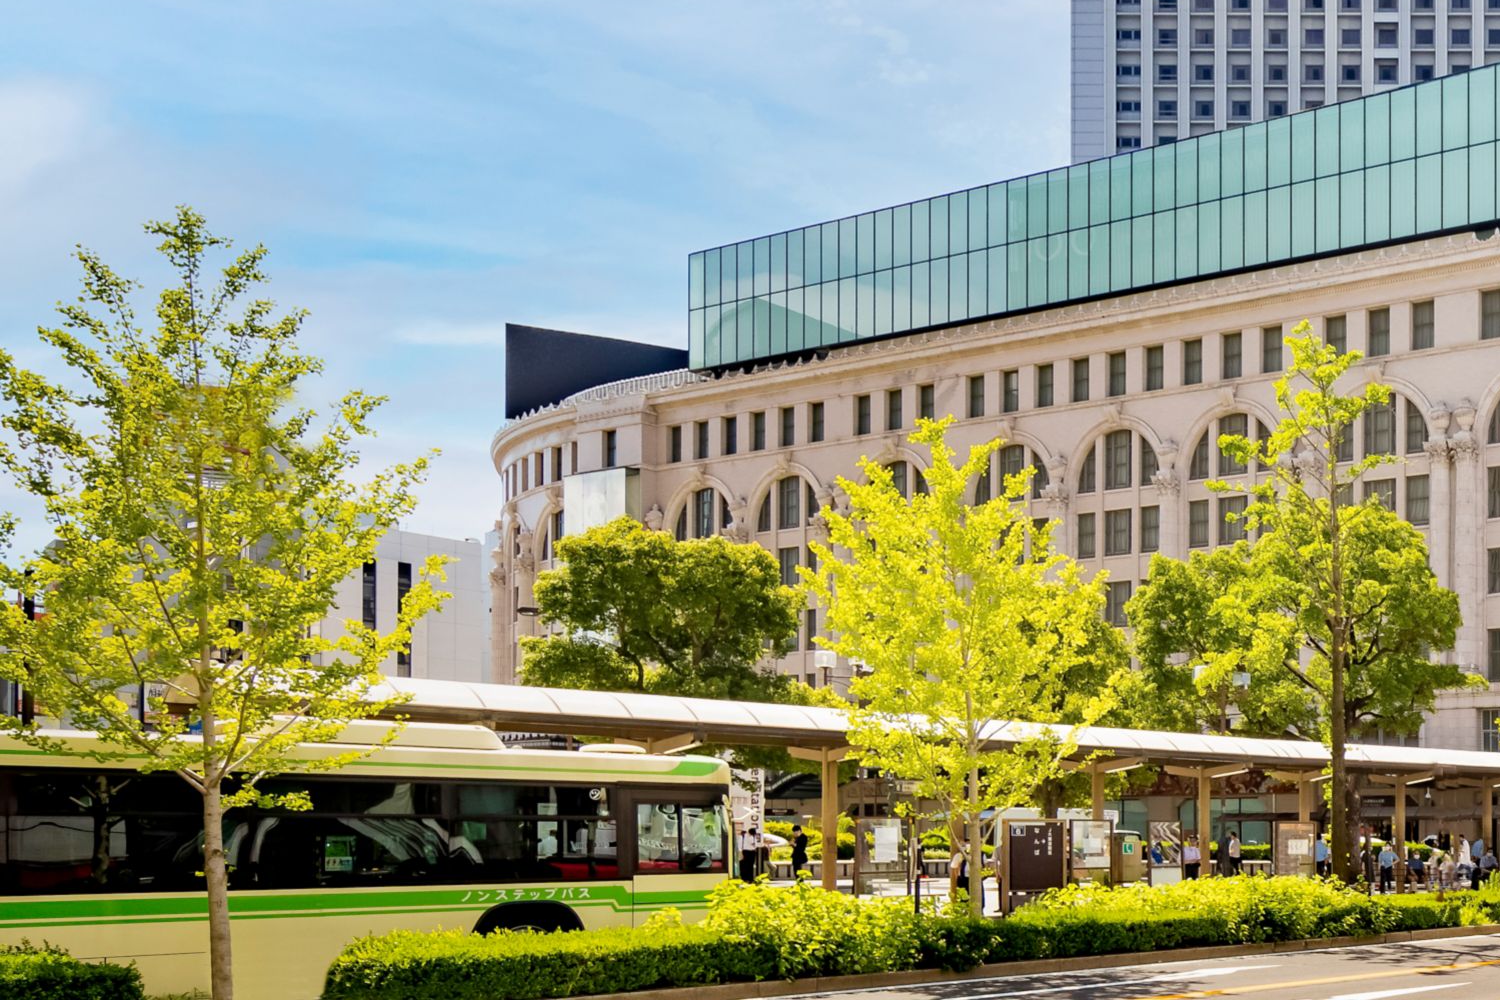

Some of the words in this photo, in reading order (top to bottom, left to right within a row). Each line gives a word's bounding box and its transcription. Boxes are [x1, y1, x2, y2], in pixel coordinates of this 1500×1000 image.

[461, 888, 591, 902] ノンステップバス
